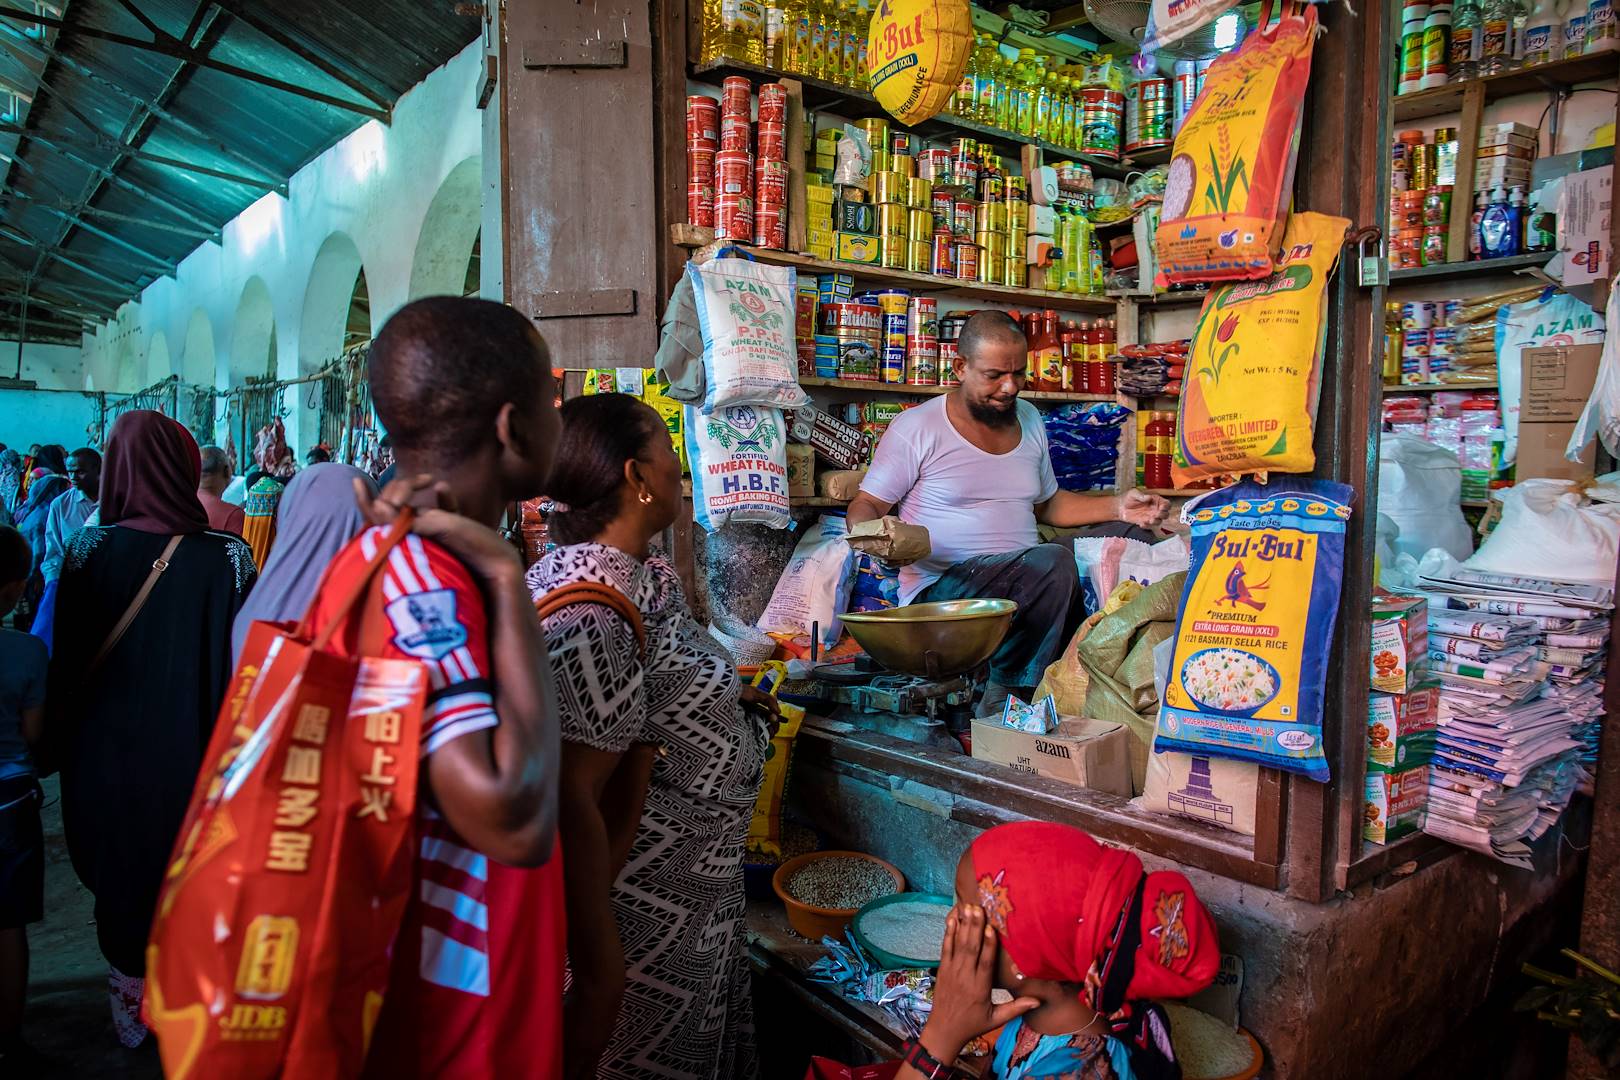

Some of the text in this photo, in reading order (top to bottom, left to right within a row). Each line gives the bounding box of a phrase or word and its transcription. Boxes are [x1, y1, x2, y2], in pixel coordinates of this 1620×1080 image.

[1060, 190, 1086, 201] MAND
[846, 205, 855, 230] SAFARI
[725, 279, 772, 298] AZAM
[825, 310, 837, 326] Al
[1532, 314, 1593, 338] AZAM
[731, 338, 762, 347] WHEAT
[1243, 367, 1255, 375] Net
[1278, 366, 1283, 374] 5
[1285, 366, 1298, 376] Kg
[817, 411, 861, 440] DEMAND
[1227, 423, 1237, 439] (Z)
[1239, 419, 1279, 434] LIMITED
[812, 430, 851, 457] DEMAND
[836, 431, 858, 449] FOIL
[829, 448, 849, 465] FOIL
[708, 460, 753, 475] WHEAT
[756, 460, 785, 476] FLOUR
[722, 473, 785, 496] H.B.F.
[710, 496, 737, 506] HOME
[738, 493, 770, 501] BAKING
[1230, 518, 1251, 527] Taste
[1207, 610, 1258, 623] PREMIUM
[1194, 622, 1274, 637] EXTRA LONG GRAIN (XXL)
[1198, 635, 1233, 646] BASMATI
[1234, 638, 1262, 648] SELLA
[1265, 641, 1289, 650] RICE
[1035, 738, 1071, 760] azam
[1017, 755, 1030, 764] UHT
[218, 1003, 287, 1029] JDB
